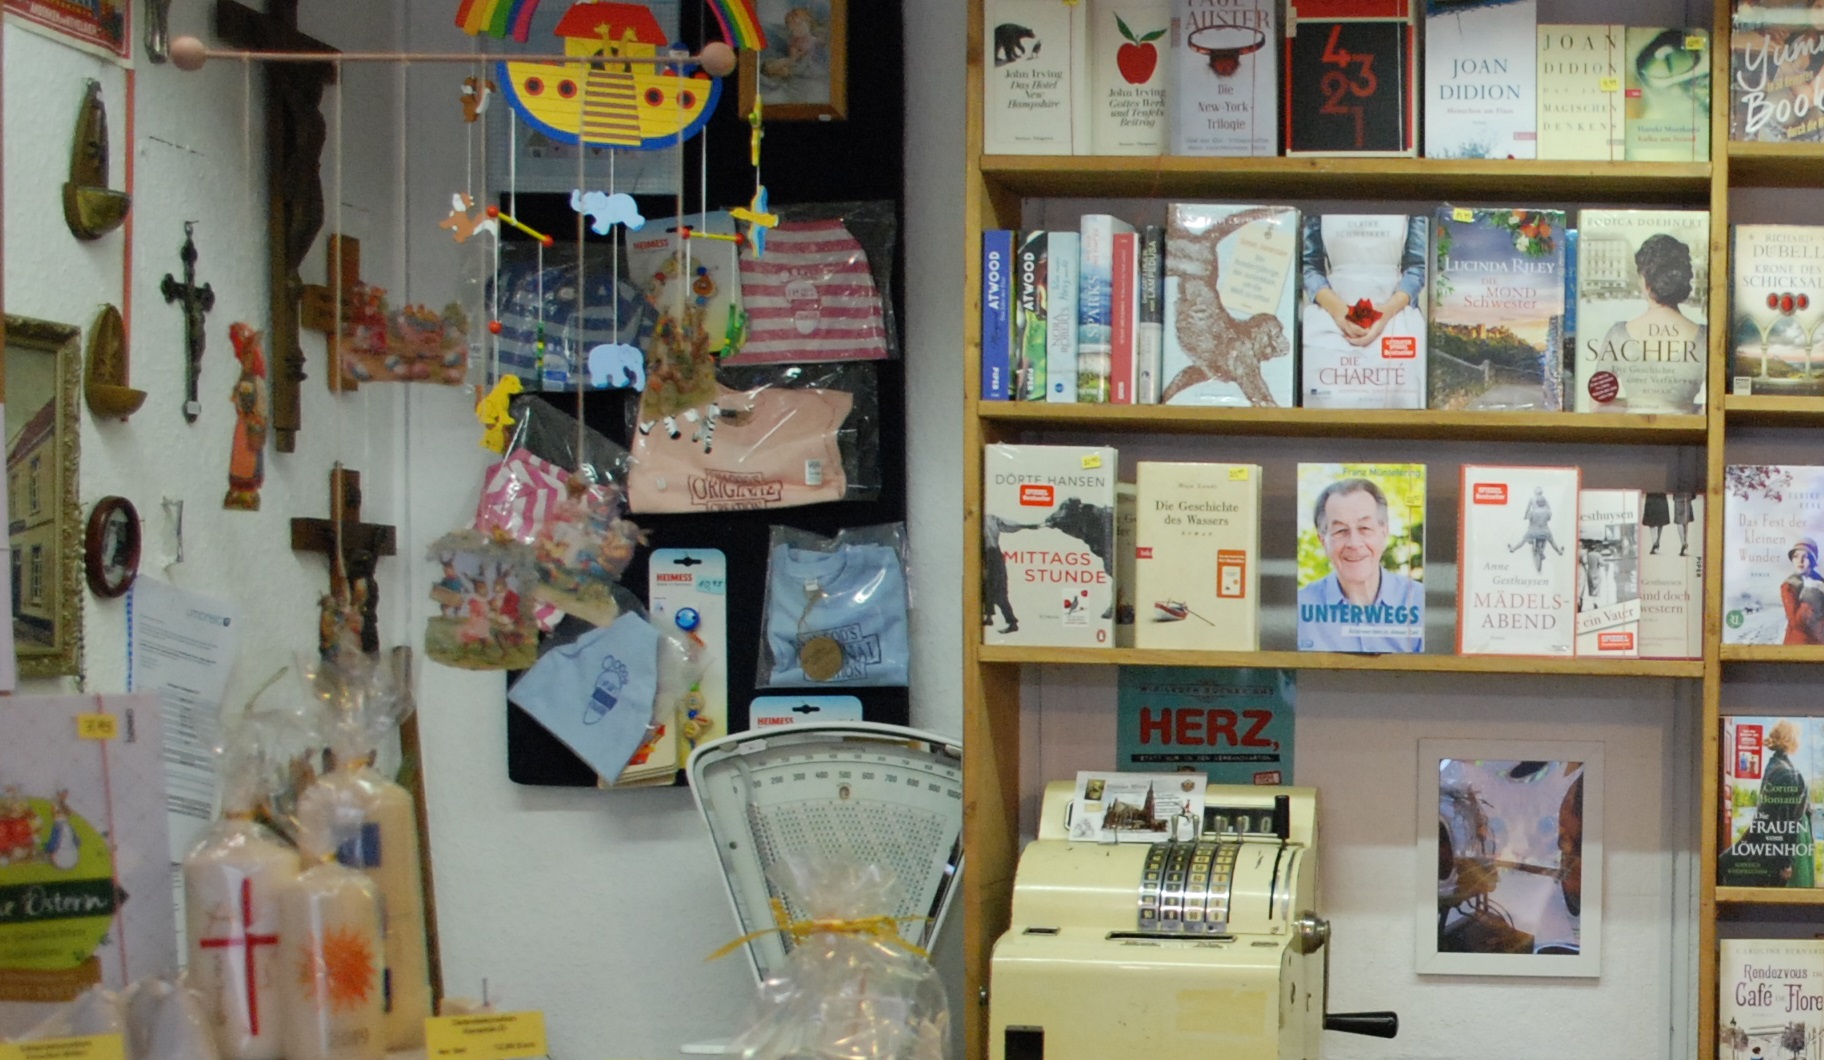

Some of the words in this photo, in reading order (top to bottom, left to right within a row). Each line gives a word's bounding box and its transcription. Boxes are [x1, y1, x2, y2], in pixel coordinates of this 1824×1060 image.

[1543, 34, 1618, 51] JOAN
[1451, 58, 1508, 79] JOAN
[1544, 61, 1618, 75] DIDION
[1439, 84, 1521, 101] DIDION
[1543, 103, 1618, 114] MAGISCHEN
[1543, 121, 1618, 132] DENKENS
[634, 239, 669, 250] HEIMESS
[1444, 257, 1510, 274] LUCINDA
[1511, 257, 1556, 274] RILEY
[987, 250, 1000, 309] ATWOOD
[1022, 251, 1035, 312] ATWOOD
[1485, 286, 1537, 299] MOND
[1087, 274, 1101, 339] SPARKS
[1648, 323, 1680, 338] DAS
[1584, 339, 1701, 364] SACHER
[1340, 356, 1360, 367] DIE
[1319, 363, 1406, 386] CHARITÉ
[1048, 474, 1105, 488] HANSEN
[1155, 501, 1175, 512] Die
[1178, 500, 1239, 514] Geschichte
[1164, 514, 1183, 526] des
[1187, 515, 1229, 526] Wassers
[1739, 513, 1759, 528] Das
[1762, 514, 1787, 529] Fest
[1789, 516, 1808, 529] der
[1744, 530, 1786, 546] kleinen
[1003, 551, 1092, 567] MITTAGS
[1739, 549, 1781, 564] Wunder
[1483, 561, 1510, 572] Anne
[656, 573, 693, 582] HEIMESS
[1024, 568, 1107, 584] STUNDE
[1493, 576, 1549, 588] Gesthuysen
[1474, 589, 1571, 610] MÄDELS-
[1666, 590, 1691, 601] doch
[1301, 604, 1419, 625] UNTERWEGS
[1481, 613, 1556, 630] ABEND
[757, 717, 794, 725] HEIMESS
[1139, 706, 1281, 752] HERZ,
[815, 771, 829, 780] 400
[838, 770, 852, 780] 500
[861, 771, 875, 781] 600
[884, 774, 898, 784] 700
[1762, 783, 1799, 794] Corina
[1755, 811, 1770, 821] Die
[1749, 819, 1809, 835] FRAUEN
[1730, 839, 1816, 858] LÖWENHOF
[1743, 964, 1808, 982] Rendezvous
[1735, 981, 1773, 1007] Café
[1783, 983, 1824, 1013] Flore
